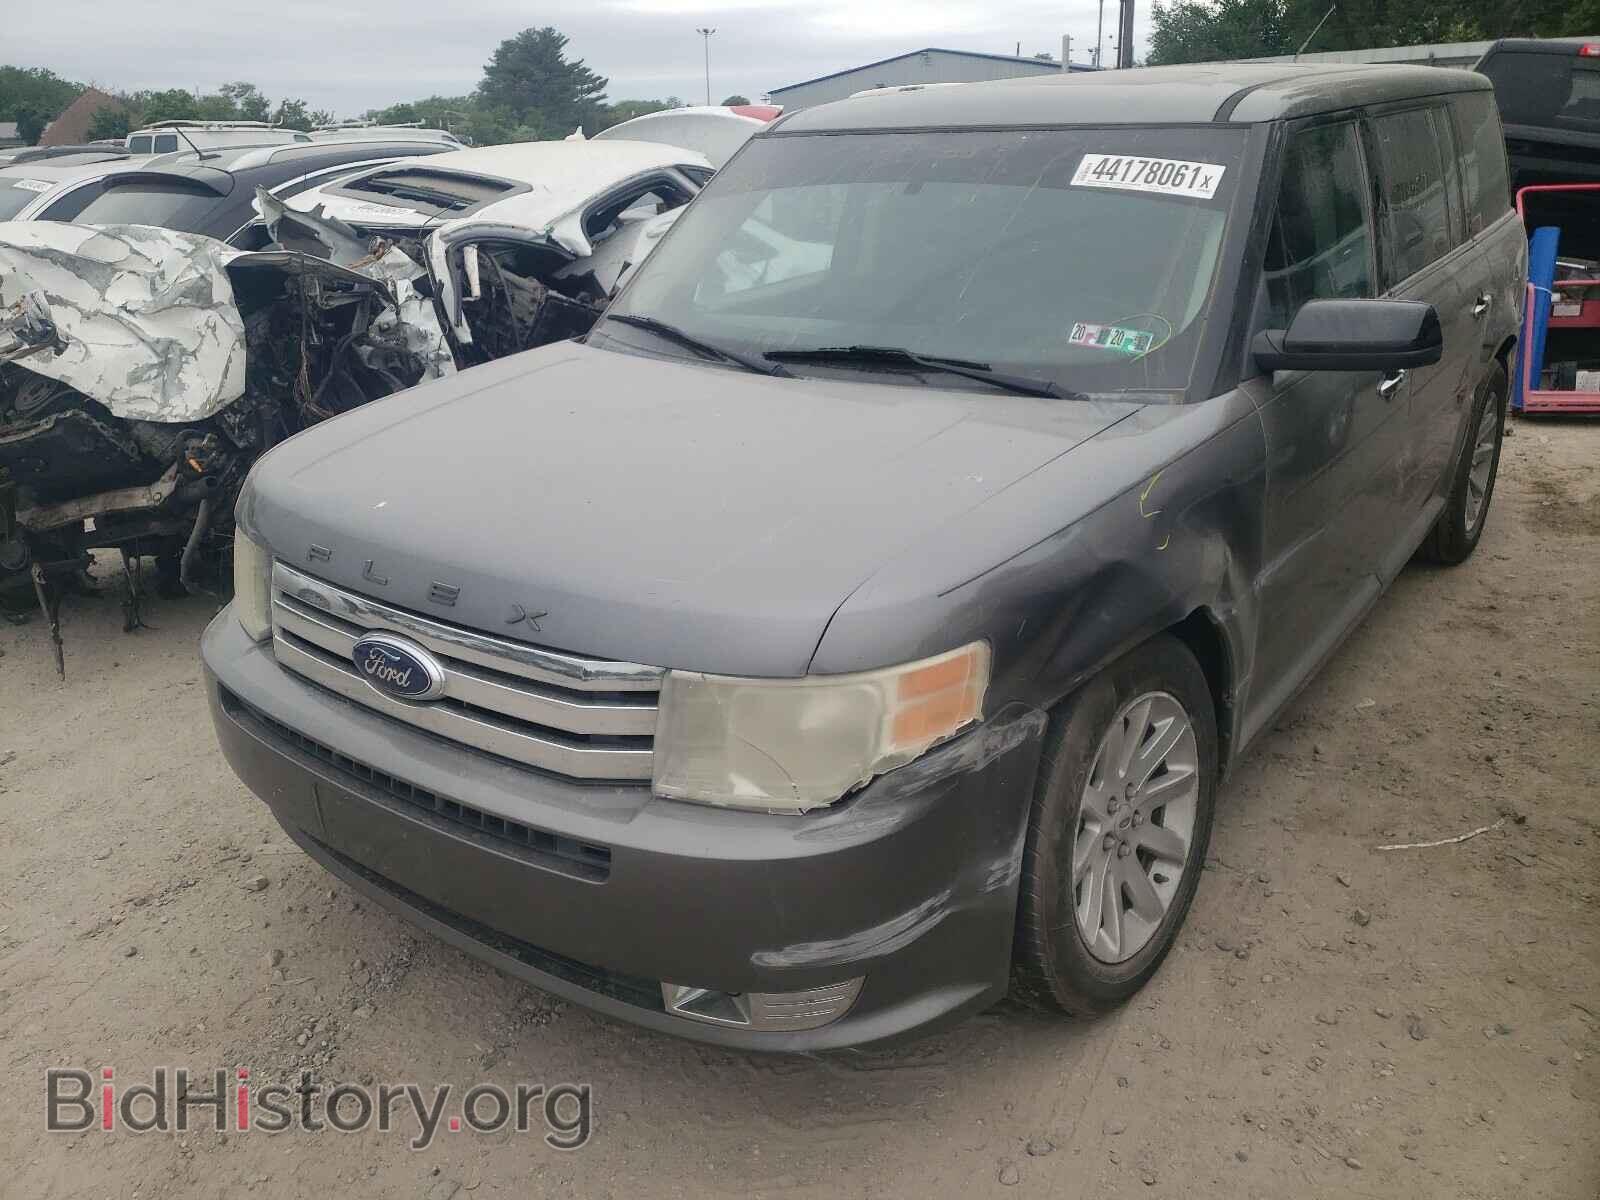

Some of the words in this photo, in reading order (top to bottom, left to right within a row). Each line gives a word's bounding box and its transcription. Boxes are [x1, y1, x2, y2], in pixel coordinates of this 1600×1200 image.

[1092, 157, 1201, 189] 44178061
[1072, 323, 1086, 341] 20
[1110, 329, 1125, 346] 20
[307, 543, 548, 632] FLEX
[364, 647, 411, 687] Ford
